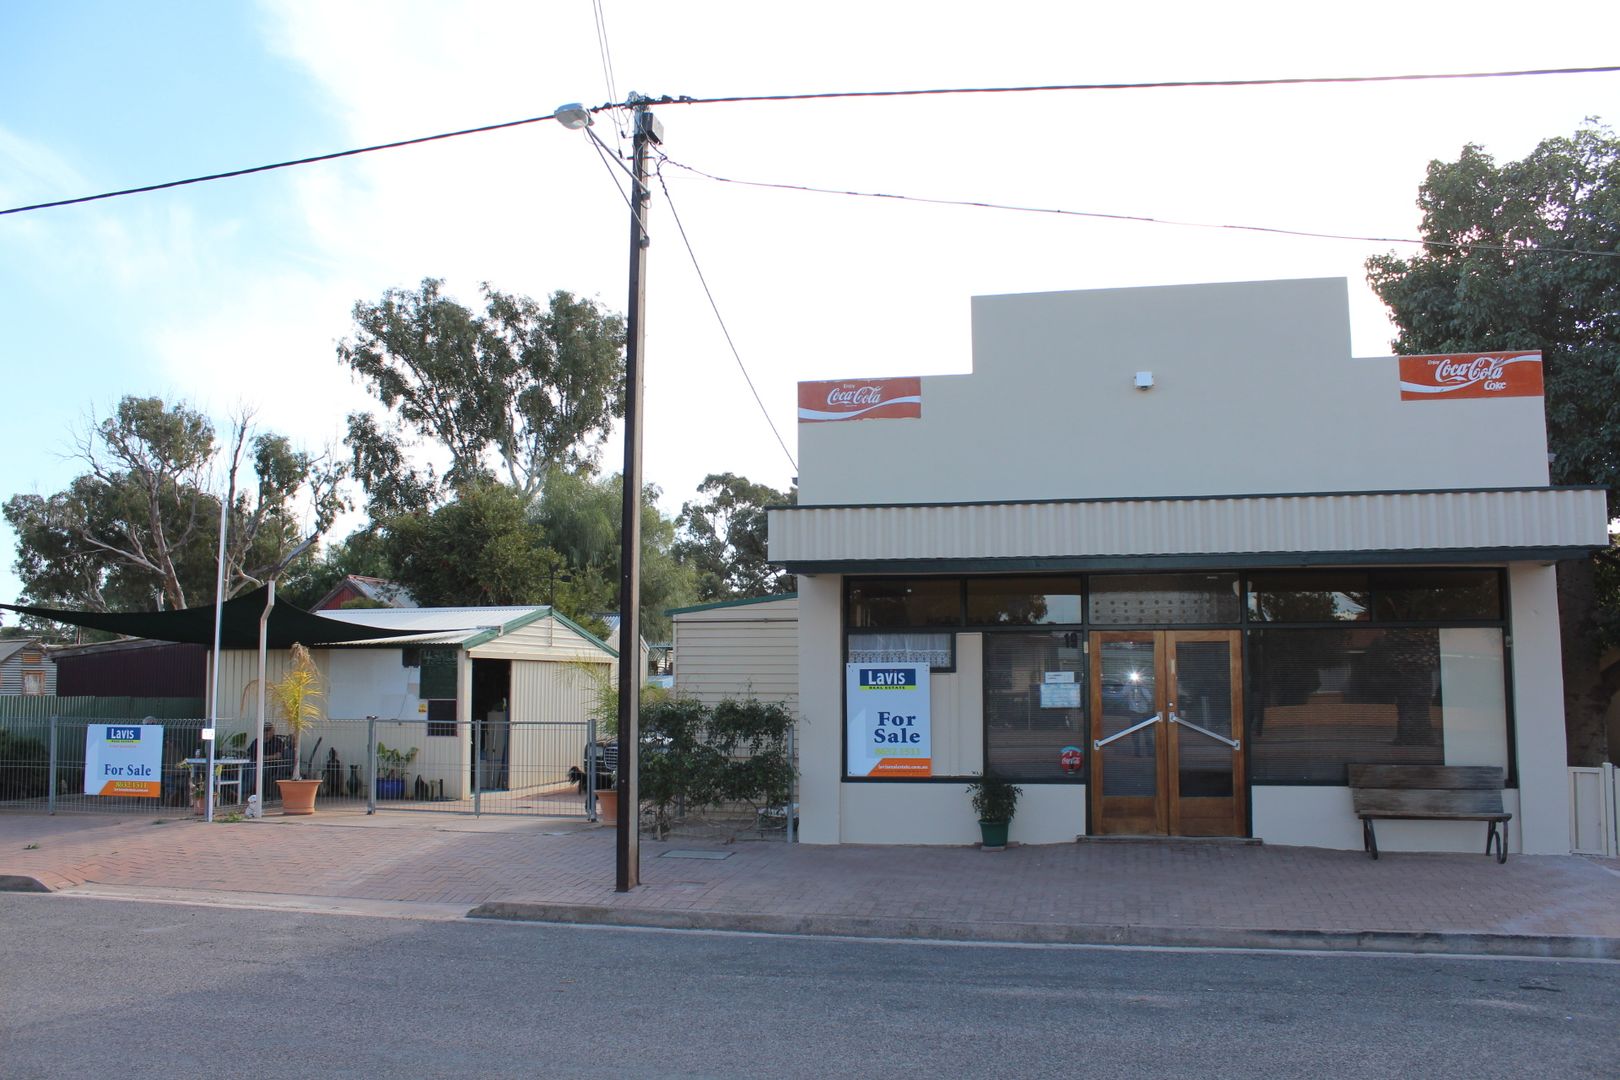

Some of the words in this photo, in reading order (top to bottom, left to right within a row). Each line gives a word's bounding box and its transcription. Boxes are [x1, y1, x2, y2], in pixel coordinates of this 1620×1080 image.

[1484, 380, 1506, 391] Coke
[868, 670, 905, 685] Lavis
[877, 711, 916, 727] For
[111, 728, 134, 739] Lavis
[873, 728, 920, 744] Sale
[105, 763, 124, 776] For
[127, 763, 152, 776] Sale
